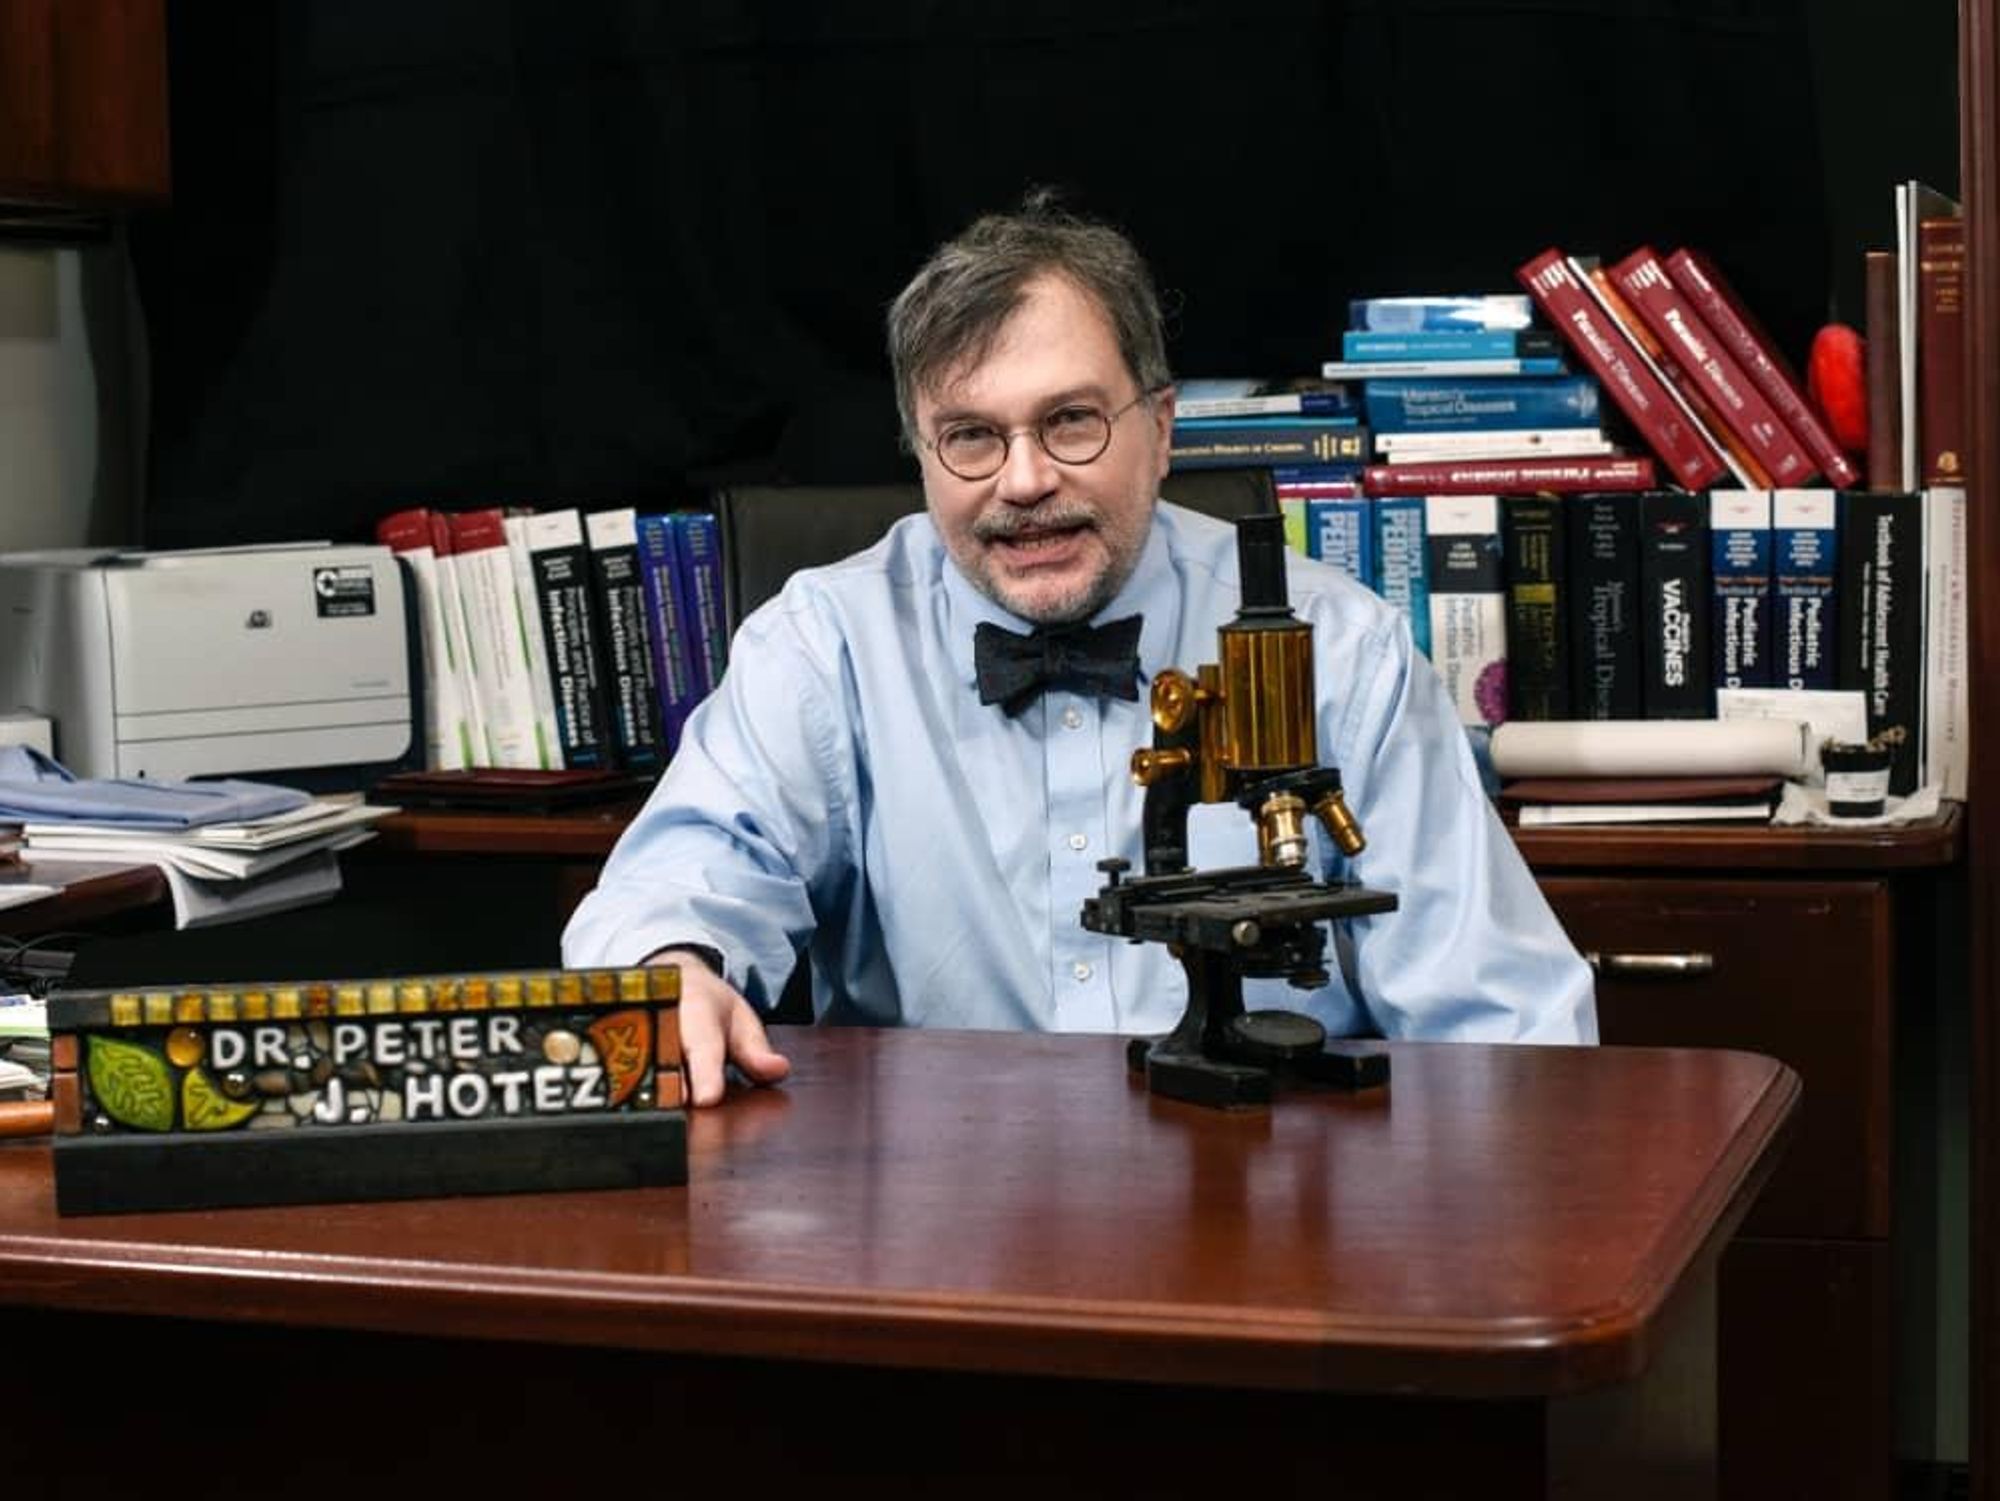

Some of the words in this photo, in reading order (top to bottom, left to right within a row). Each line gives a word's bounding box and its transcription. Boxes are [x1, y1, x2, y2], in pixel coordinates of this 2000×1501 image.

[1876, 513, 1893, 566] Textbook
[1877, 569, 1893, 583] of
[1590, 584, 1616, 658] Tropical
[1663, 578, 1684, 687] VACCINES
[1726, 597, 1741, 674] Infectious
[1742, 597, 1757, 666] Pediatric
[1789, 597, 1804, 675] Infectious
[1805, 597, 1821, 667] Pediatric
[1875, 584, 1892, 647] Adolescent
[548, 590, 572, 672] Infectious
[560, 676, 578, 748] Diseases
[573, 650, 587, 676] and
[608, 588, 630, 672] Infectious
[619, 676, 637, 748] Diseases
[632, 649, 646, 675] and
[1874, 649, 1890, 688] Health
[576, 678, 591, 727] Practice
[634, 677, 650, 726] Practice
[1873, 690, 1889, 716] Care
[583, 730, 598, 746] of
[641, 730, 654, 745] of
[212, 1029, 311, 1069] DR.
[333, 1016, 523, 1064] PETER
[313, 1079, 369, 1125] J.
[405, 1065, 606, 1120] HOTEZ
